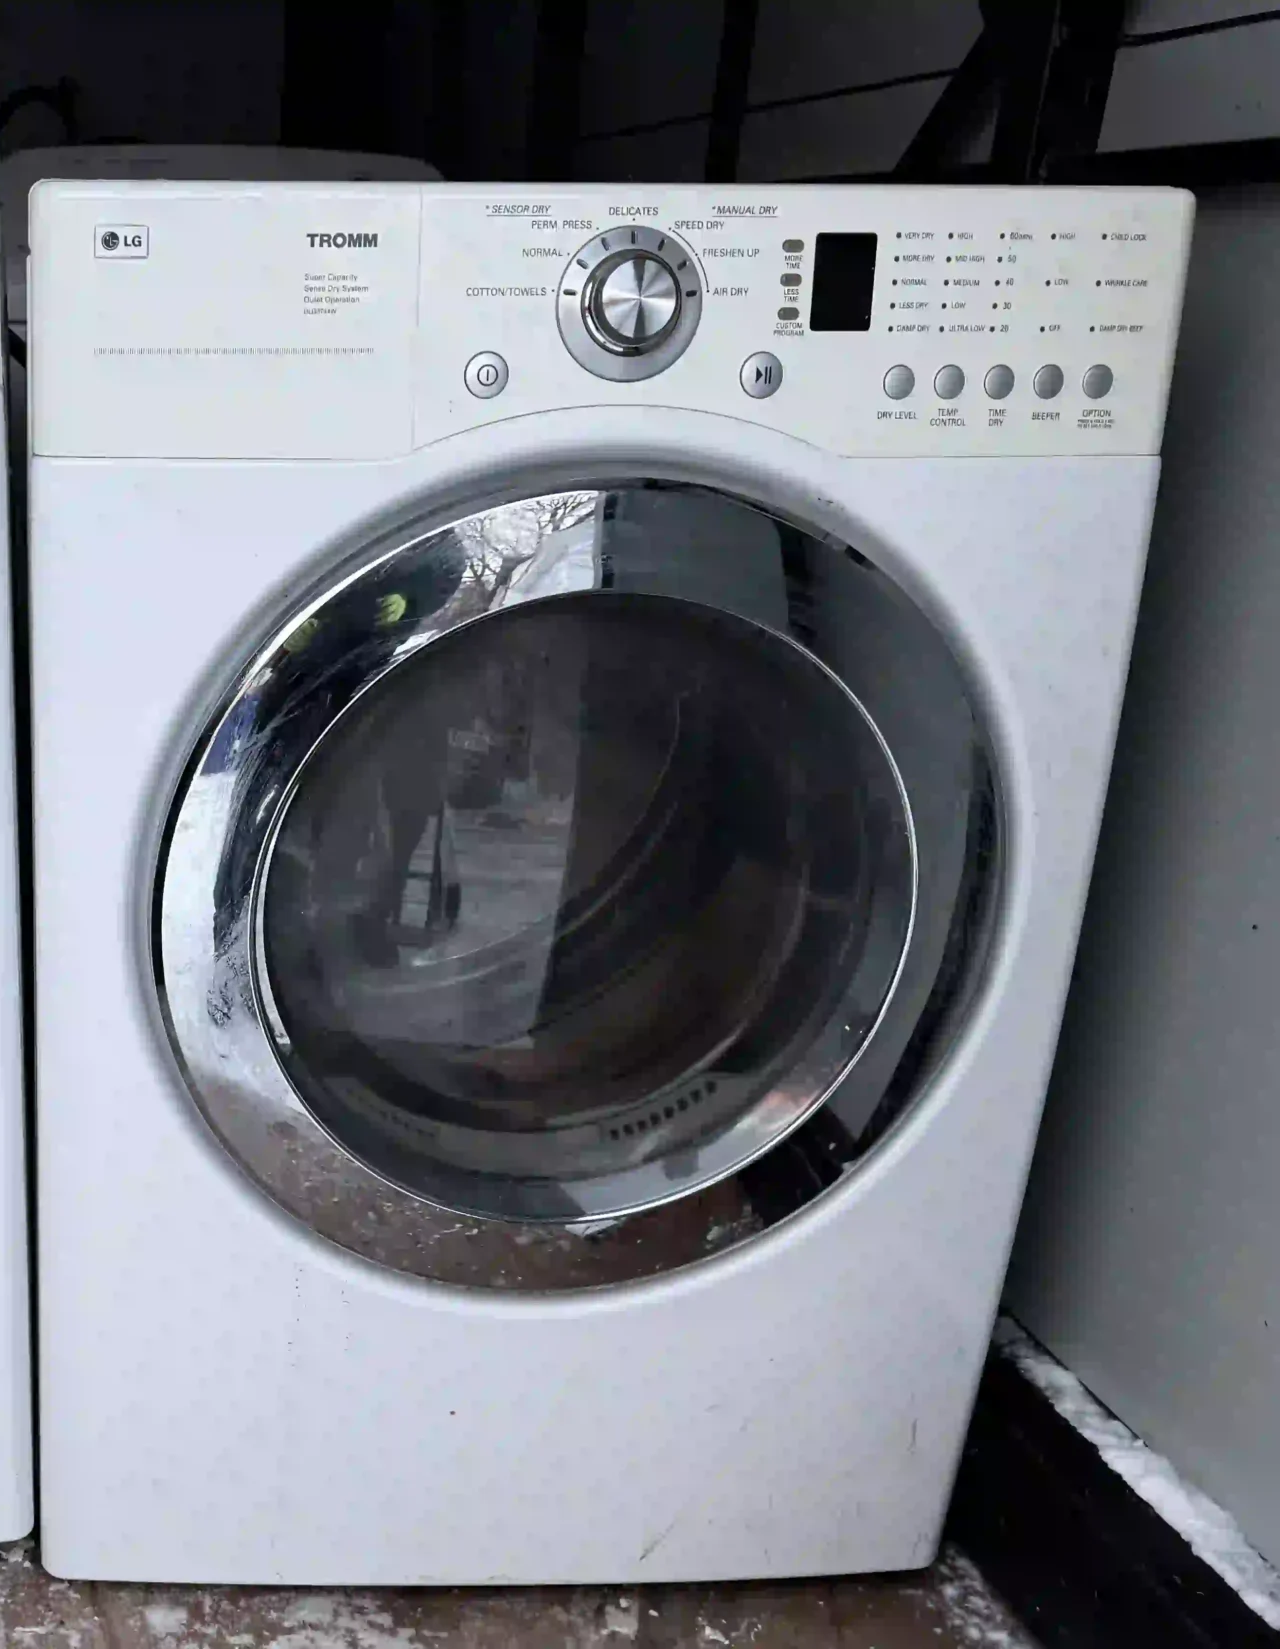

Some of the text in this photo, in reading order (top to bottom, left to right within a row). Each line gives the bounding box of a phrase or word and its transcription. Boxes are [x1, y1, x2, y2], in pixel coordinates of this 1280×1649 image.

[532, 205, 551, 214] DRY
[609, 207, 658, 215] DELICATES
[759, 206, 778, 214] DRY
[563, 220, 592, 229] PRESS
[675, 221, 725, 229] SPEED DRY
[124, 236, 142, 247] LG
[307, 233, 378, 248] TROMM
[703, 249, 760, 258] FRESHEN UP
[328, 273, 358, 282] Capacity
[342, 284, 368, 292] System
[466, 287, 546, 296] COTTON/TOWELS
[731, 288, 748, 296] DRY
[325, 296, 360, 304] Operation
[877, 411, 918, 420] DRY LEVEL
[988, 409, 1006, 417] TIME
[1032, 412, 1060, 420] BEEPER
[930, 418, 966, 427] CONTROL
[989, 418, 1004, 427] DRY
